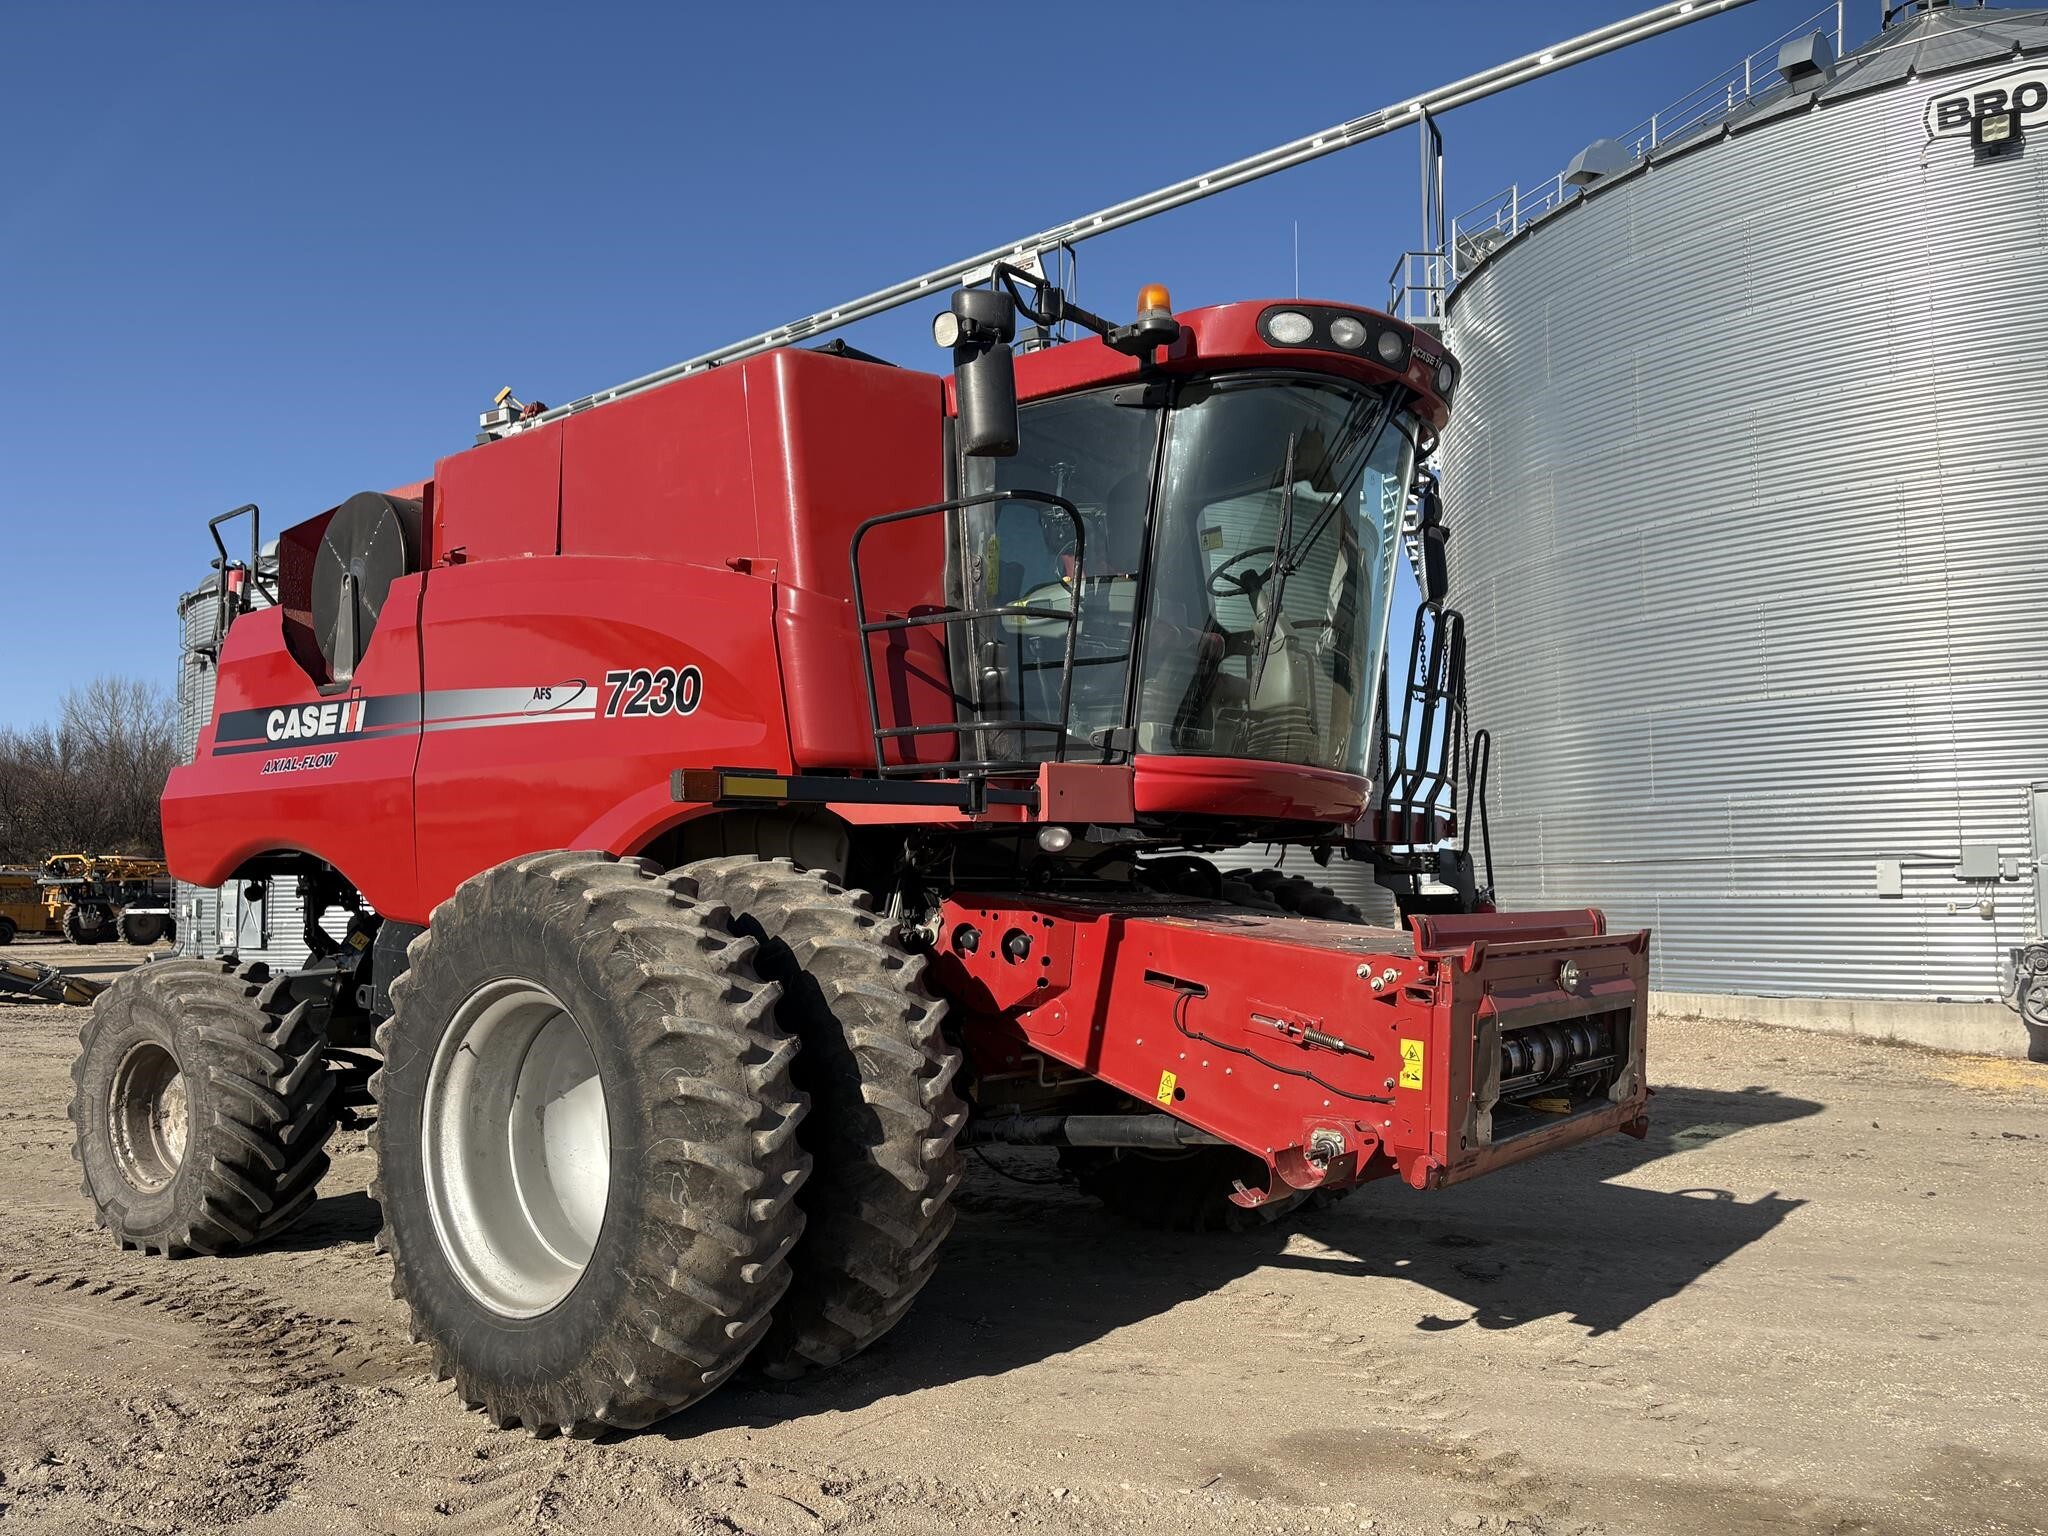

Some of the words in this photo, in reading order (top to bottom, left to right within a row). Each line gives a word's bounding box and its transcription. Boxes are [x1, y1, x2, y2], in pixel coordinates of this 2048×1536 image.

[532, 687, 552, 701] AFS
[604, 664, 704, 719] 7230
[266, 703, 339, 742] CASE
[261, 752, 339, 775] AXIAL-FLOW
